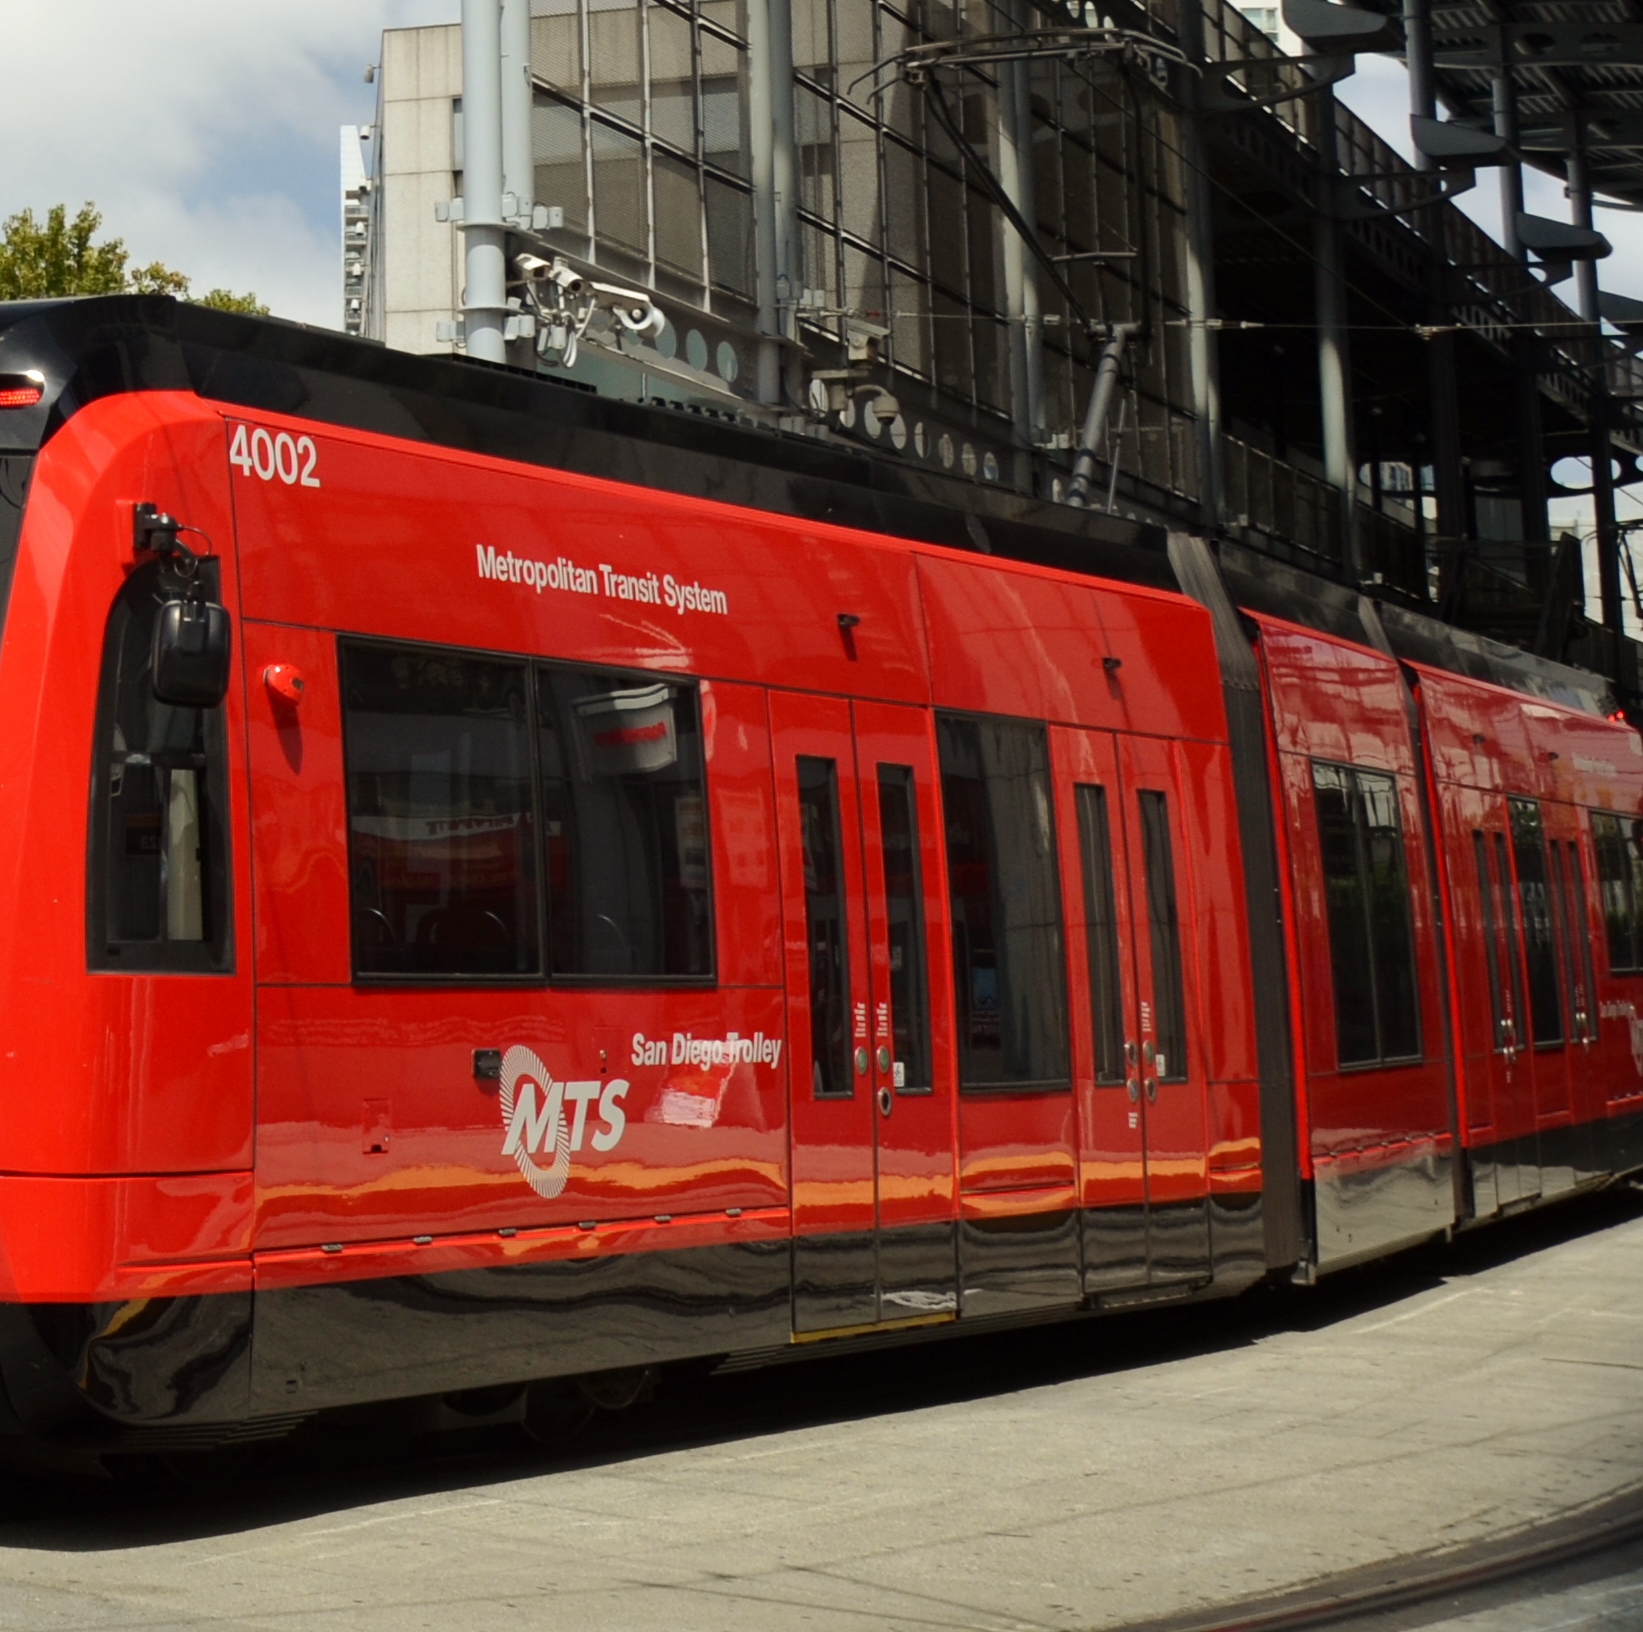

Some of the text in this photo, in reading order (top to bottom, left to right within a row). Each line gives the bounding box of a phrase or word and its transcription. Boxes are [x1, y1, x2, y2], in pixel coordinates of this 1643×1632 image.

[229, 424, 321, 488] 4002
[476, 543, 728, 615] Metropolitan Transit System
[631, 1031, 782, 1071] San Diego Trolley
[500, 1078, 631, 1156] MTS
